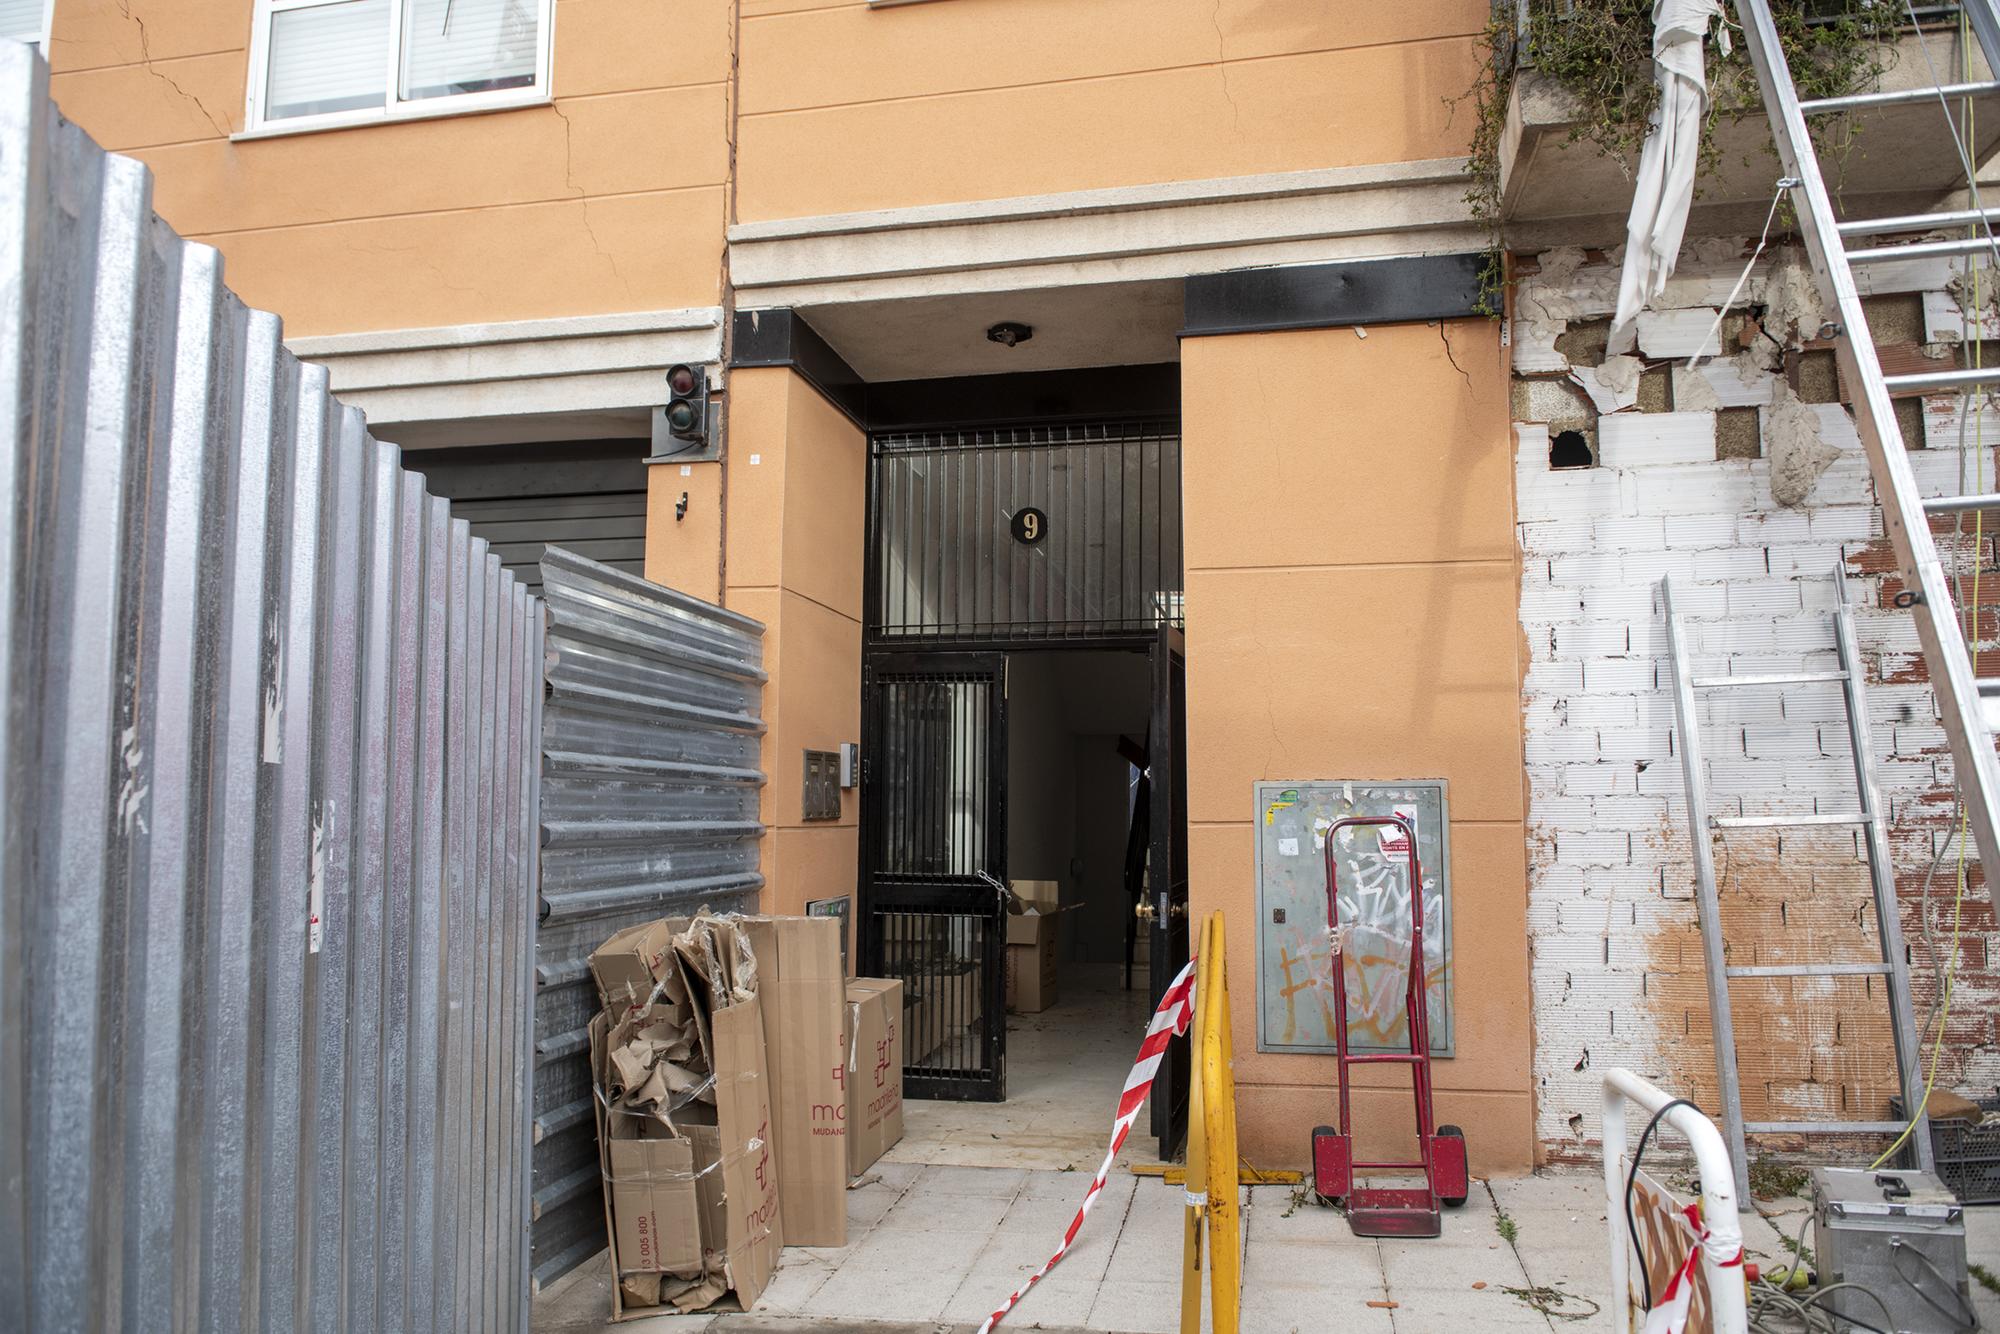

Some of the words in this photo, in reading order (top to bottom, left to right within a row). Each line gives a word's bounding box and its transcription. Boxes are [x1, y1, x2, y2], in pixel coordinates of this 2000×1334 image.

[1023, 513, 1039, 539] 9
[638, 1216, 648, 1234] 800
[640, 1237, 650, 1256] 005
